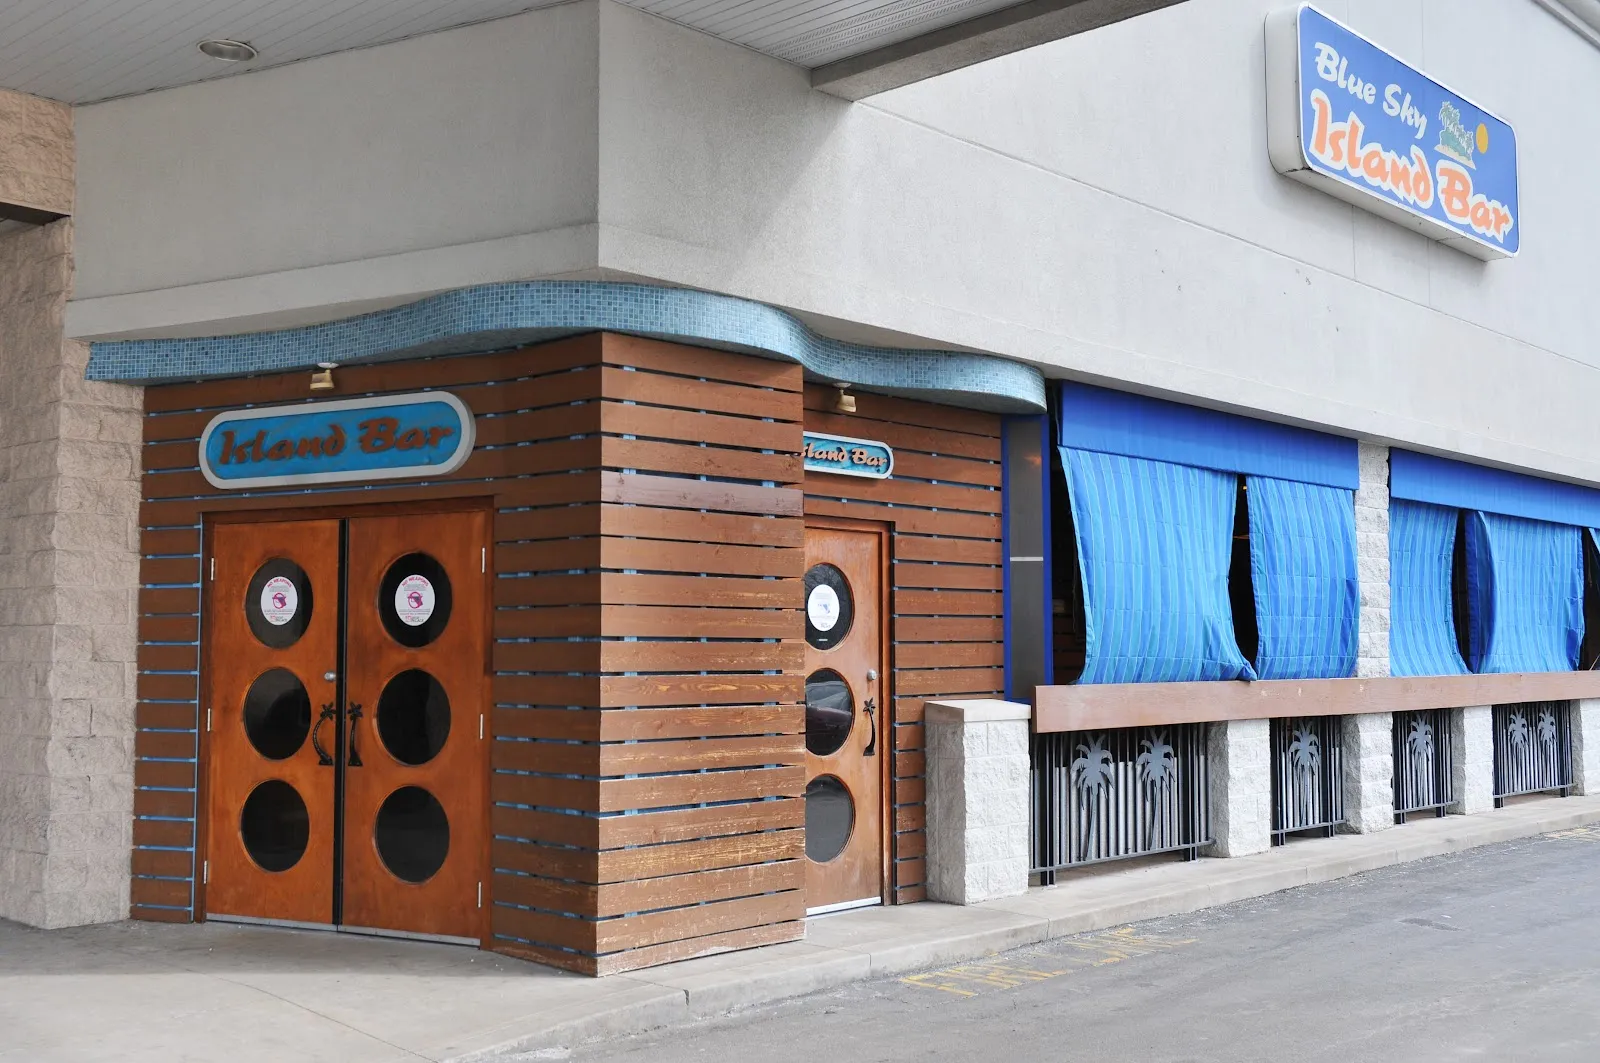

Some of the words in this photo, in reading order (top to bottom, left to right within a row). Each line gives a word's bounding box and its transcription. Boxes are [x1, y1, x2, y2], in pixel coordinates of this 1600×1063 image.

[1314, 42, 1376, 104] Blue
[1383, 83, 1427, 139] Sky
[1310, 91, 1433, 207] Island
[1437, 162, 1513, 242] Bar
[219, 423, 346, 465] Island
[358, 417, 455, 453] Bar
[803, 442, 847, 462] sland
[852, 447, 888, 466] Bar
